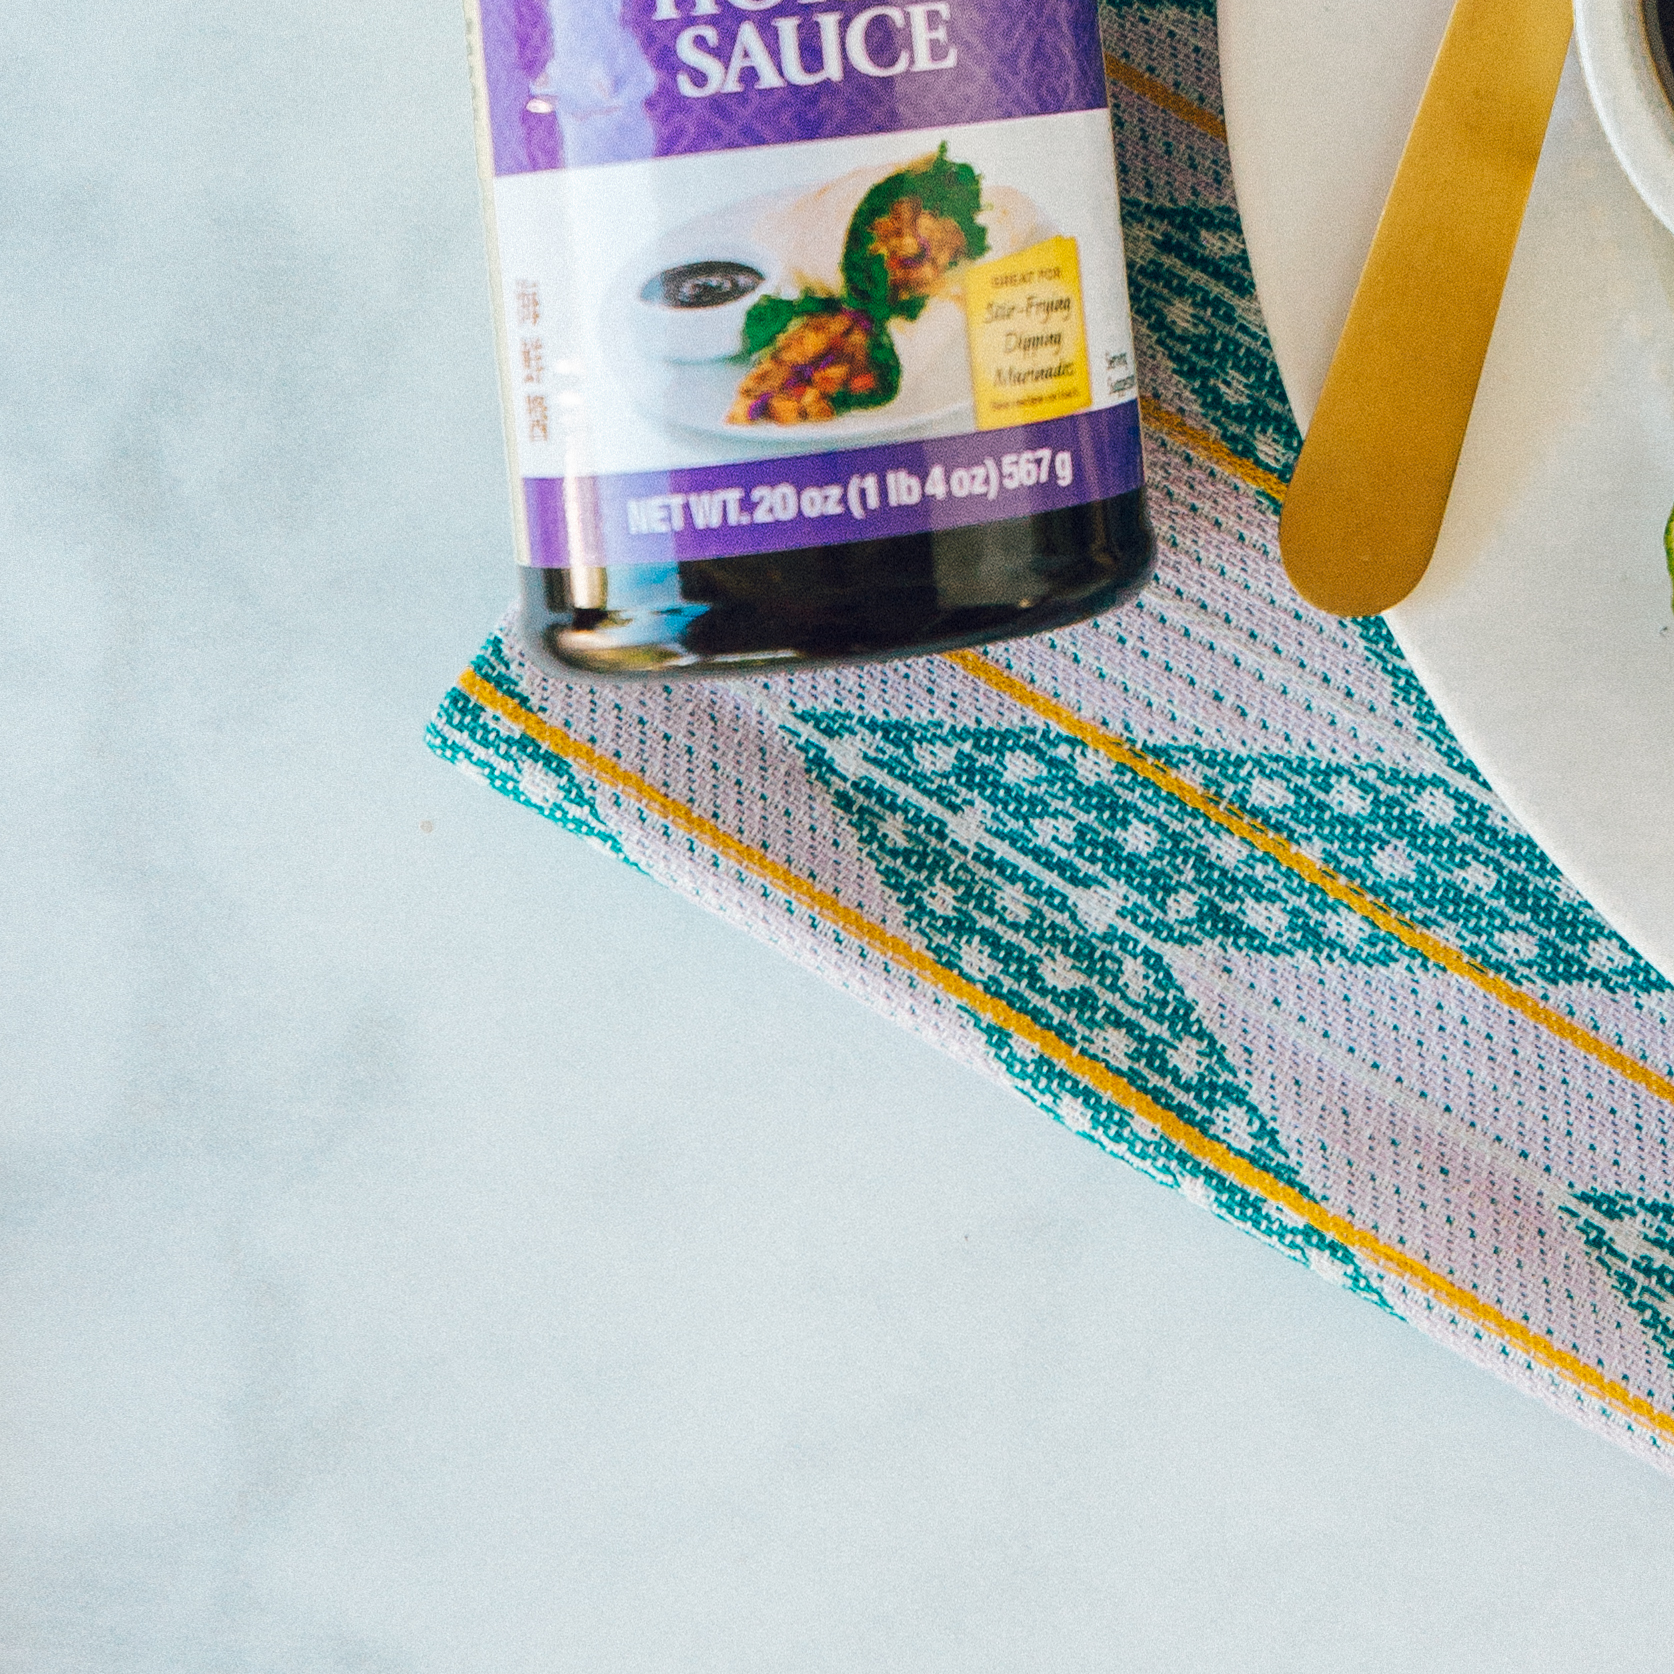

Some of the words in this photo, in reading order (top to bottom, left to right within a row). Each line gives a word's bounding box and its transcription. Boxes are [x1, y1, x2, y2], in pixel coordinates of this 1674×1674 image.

[676, 4, 958, 98] SAUCE
[991, 270, 1035, 289] GREAT
[1038, 266, 1062, 281] FOR
[983, 295, 1072, 325] Stir-Frying
[1004, 331, 1063, 358] Dipping
[627, 495, 687, 535] NET
[688, 487, 750, 530] WT.
[752, 483, 799, 524] 20
[801, 483, 845, 518] oz
[847, 471, 881, 520] (1
[886, 469, 923, 507] lb
[924, 464, 949, 501] 4
[950, 455, 999, 501] oz)
[1001, 447, 1053, 490] 567
[1055, 449, 1074, 487] g
